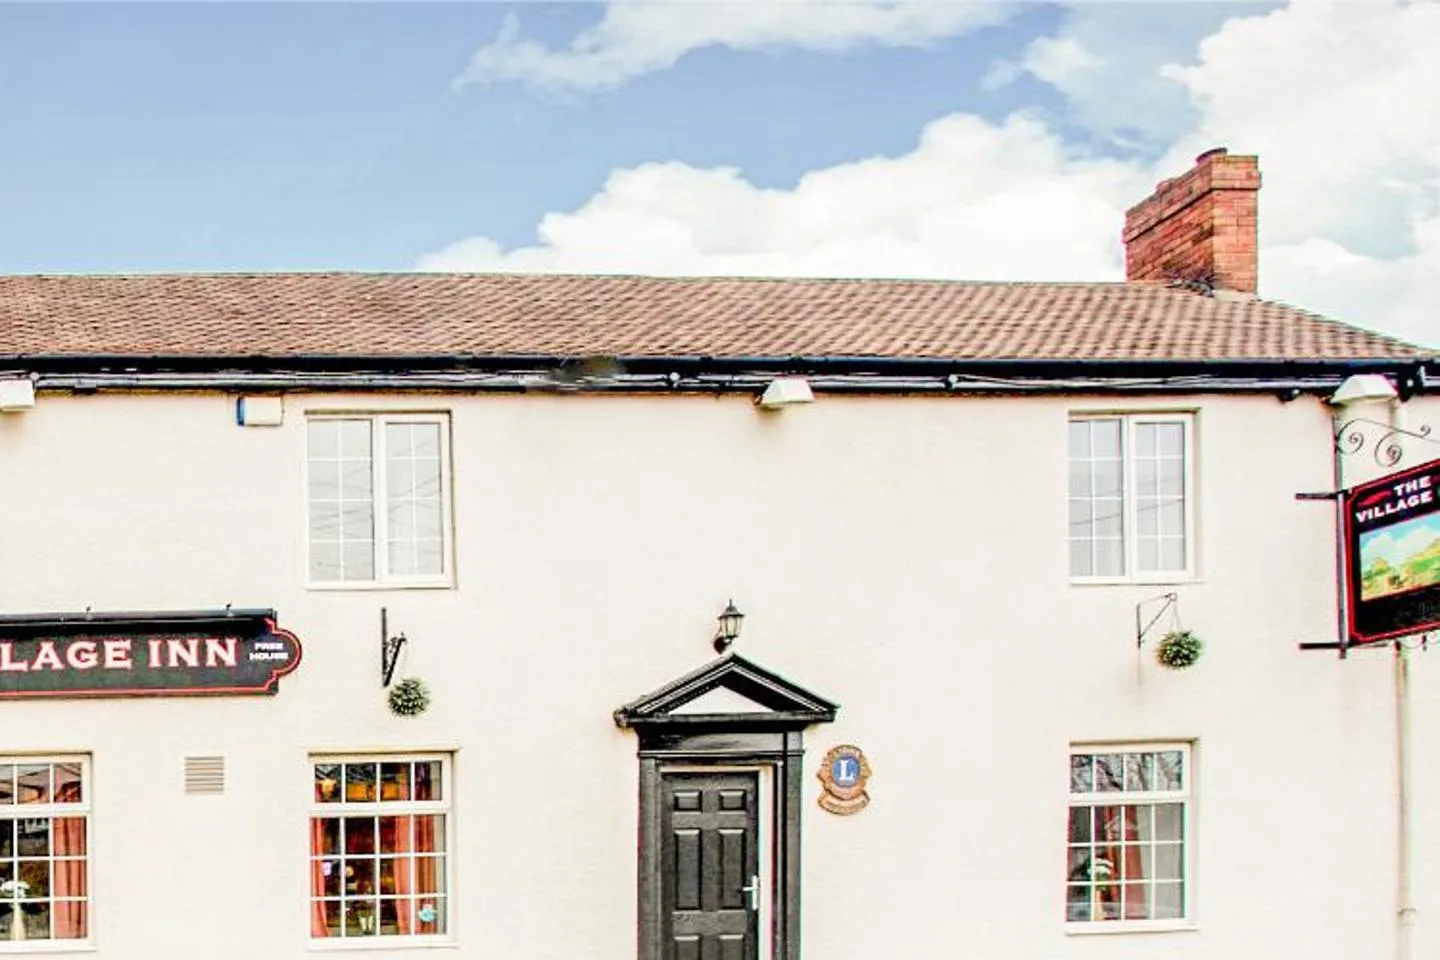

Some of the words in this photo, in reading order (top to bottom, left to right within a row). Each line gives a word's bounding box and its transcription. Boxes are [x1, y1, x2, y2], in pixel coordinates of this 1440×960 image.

[1393, 476, 1432, 496] THE
[1355, 490, 1433, 523] VILLAGE
[147, 637, 239, 669] INN
[249, 652, 289, 661] HOUSE
[839, 759, 855, 780] L
